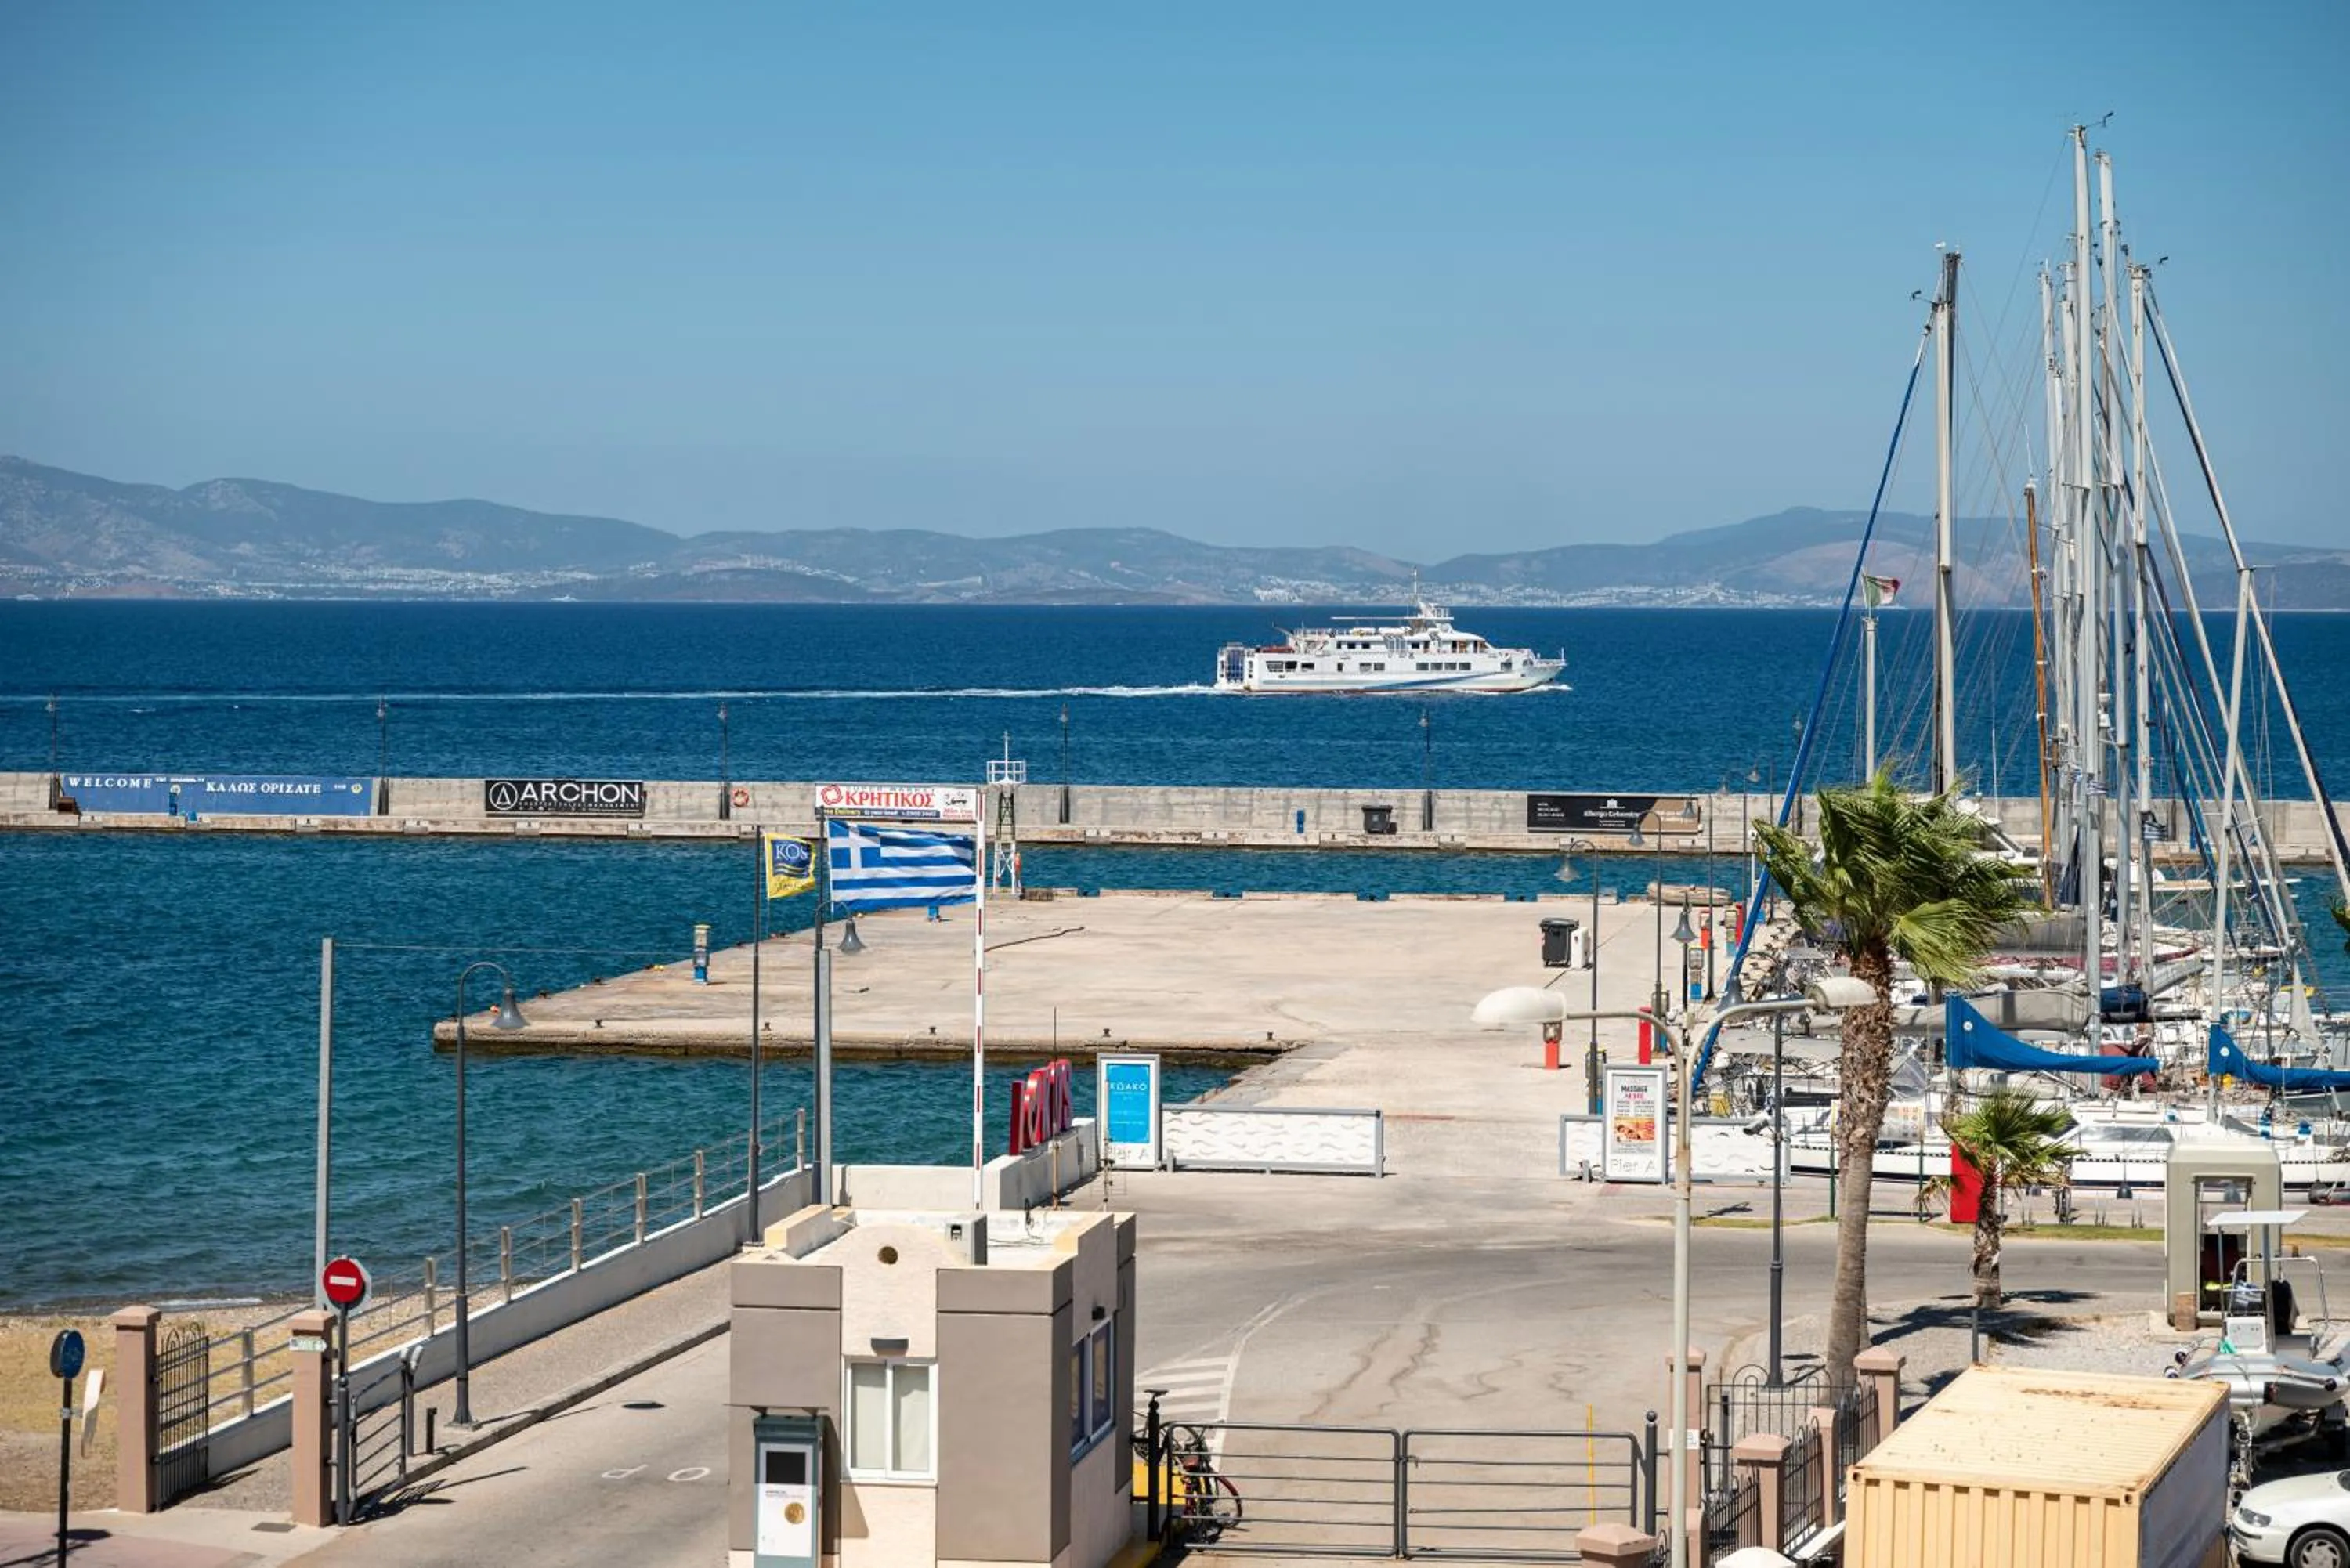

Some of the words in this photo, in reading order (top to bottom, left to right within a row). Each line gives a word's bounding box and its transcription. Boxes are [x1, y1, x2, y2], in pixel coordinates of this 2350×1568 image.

[69, 776, 153, 789] WELCOME
[261, 783, 321, 793] ΟΡΙΣΑΤΕ
[520, 782, 639, 803] ARCHON
[845, 790, 935, 807] ΚΡΗΤΙΚΟΣ
[776, 844, 808, 860] KOS
